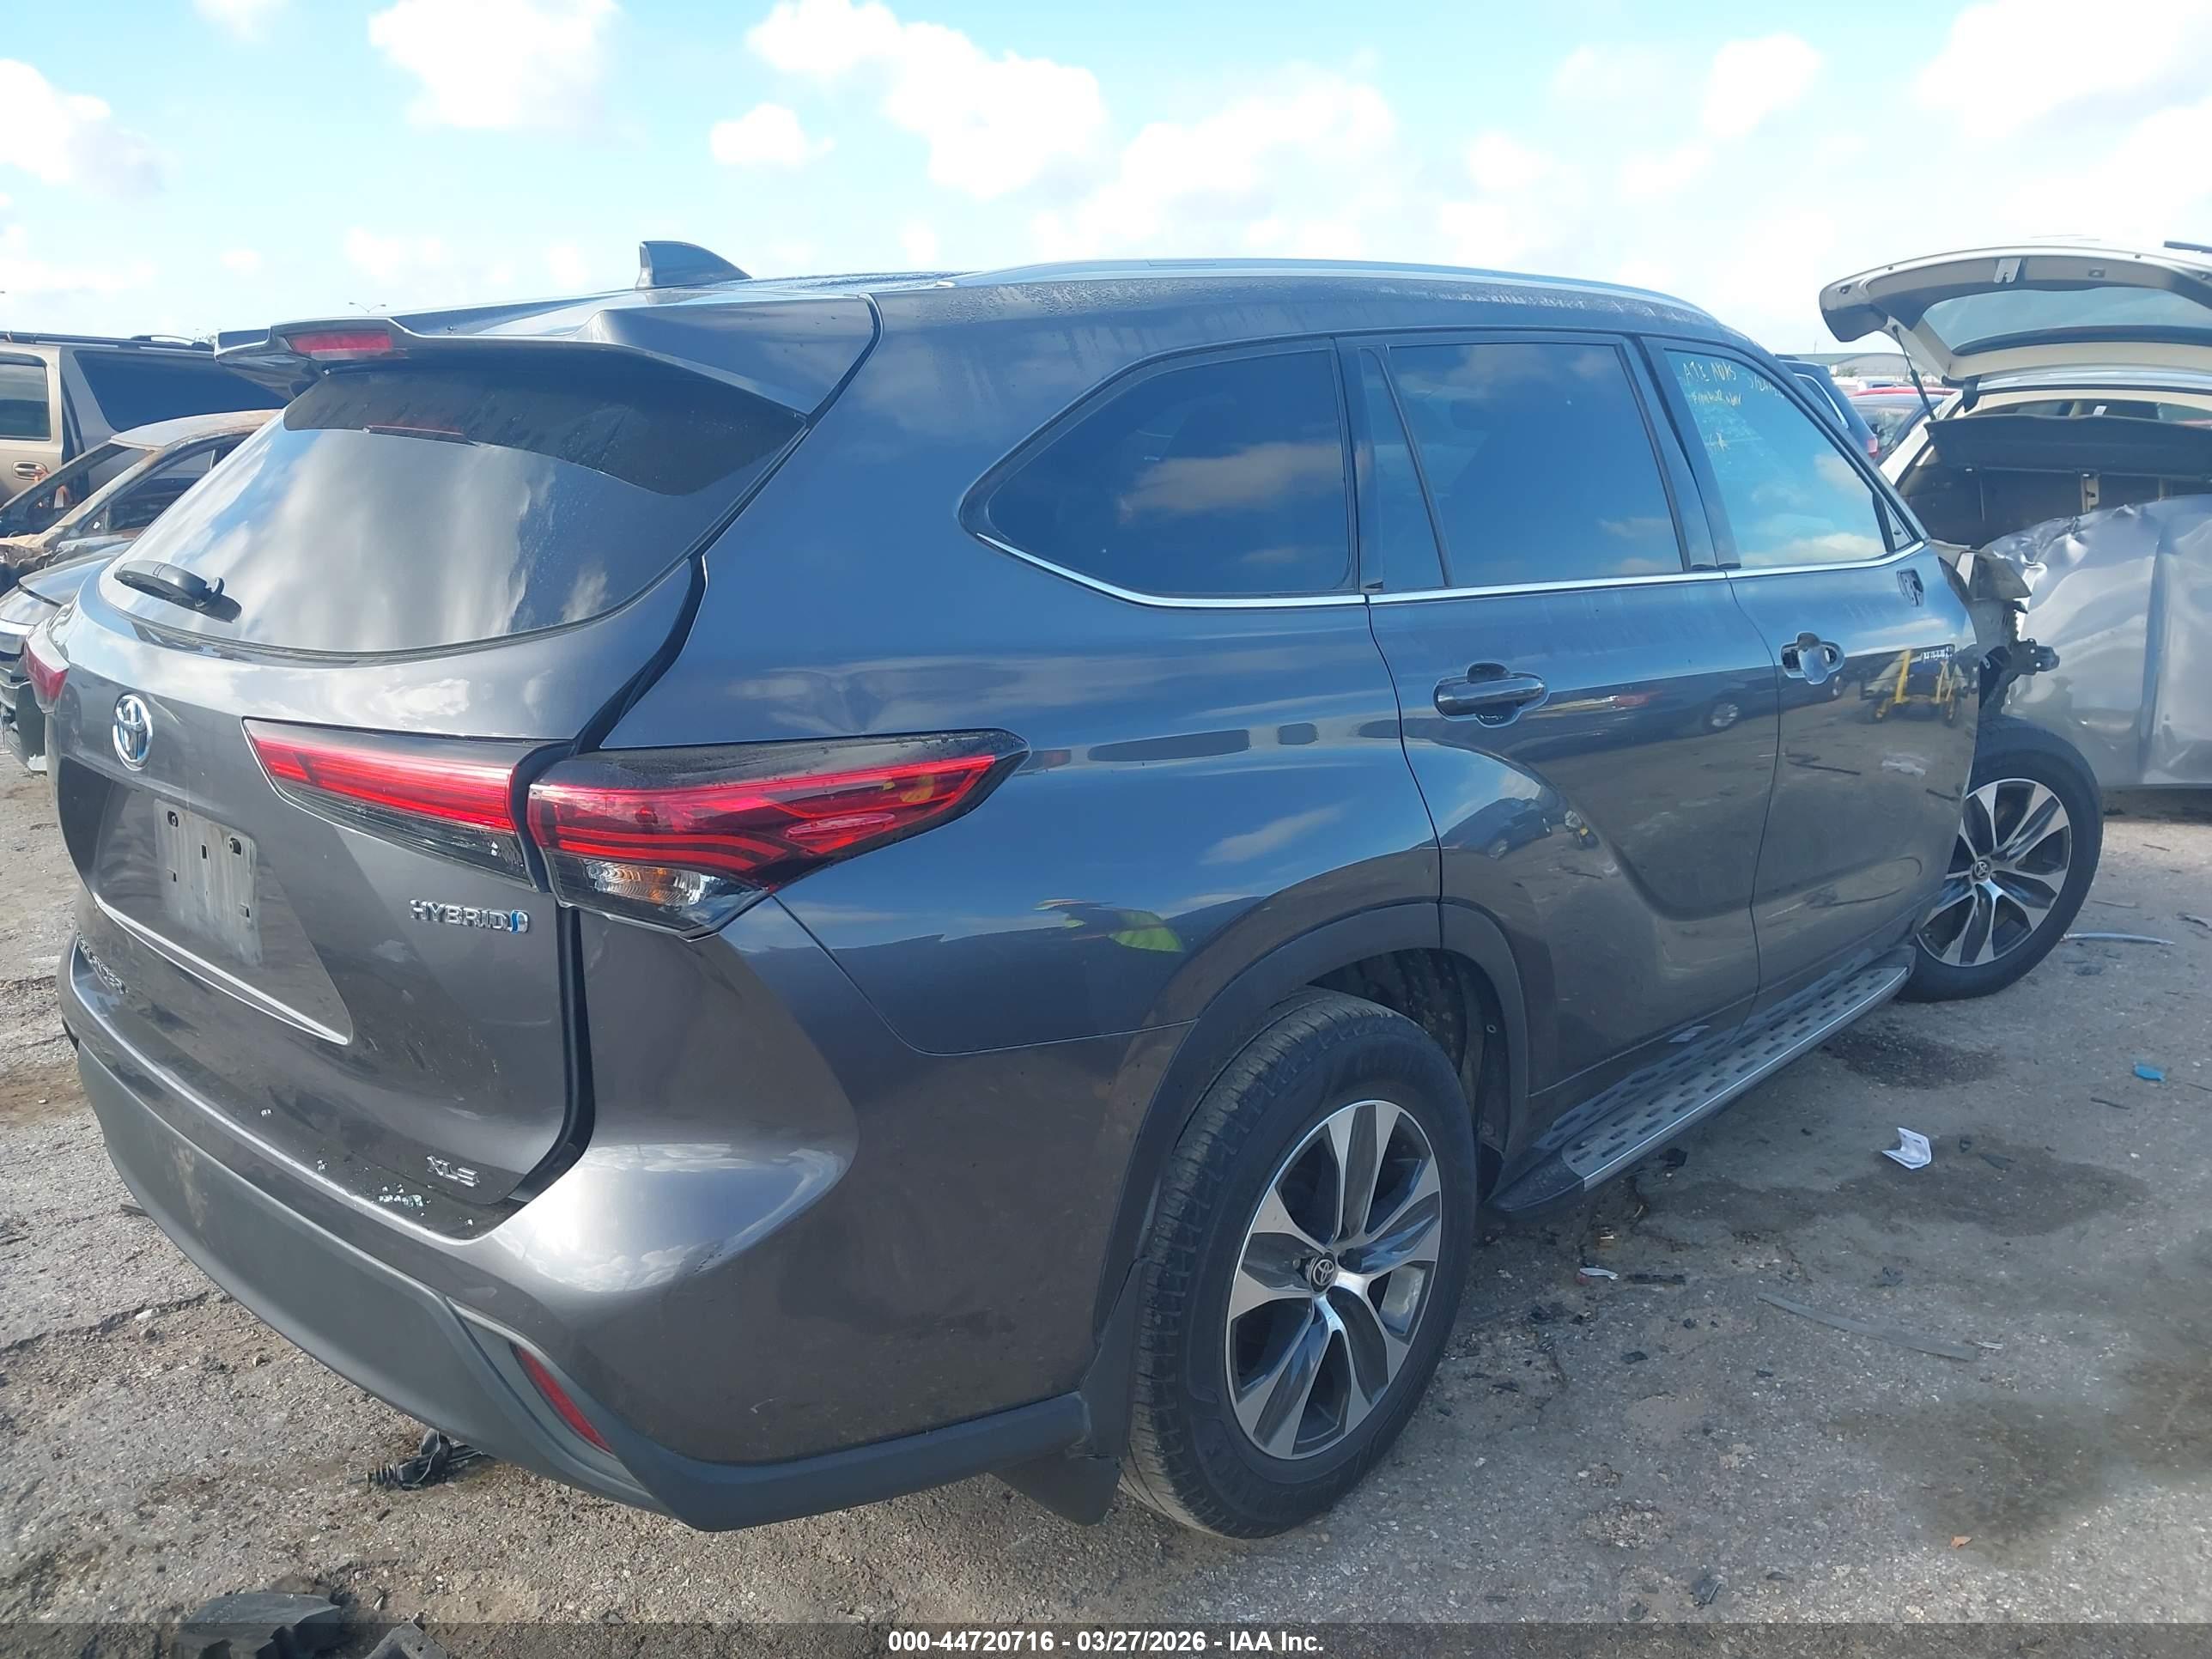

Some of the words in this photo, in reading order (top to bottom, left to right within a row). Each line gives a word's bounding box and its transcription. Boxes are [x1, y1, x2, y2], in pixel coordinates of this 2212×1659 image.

[410, 899, 513, 932] HYBRID
[76, 929, 129, 996] LANDER
[426, 1155, 480, 1188] XLE
